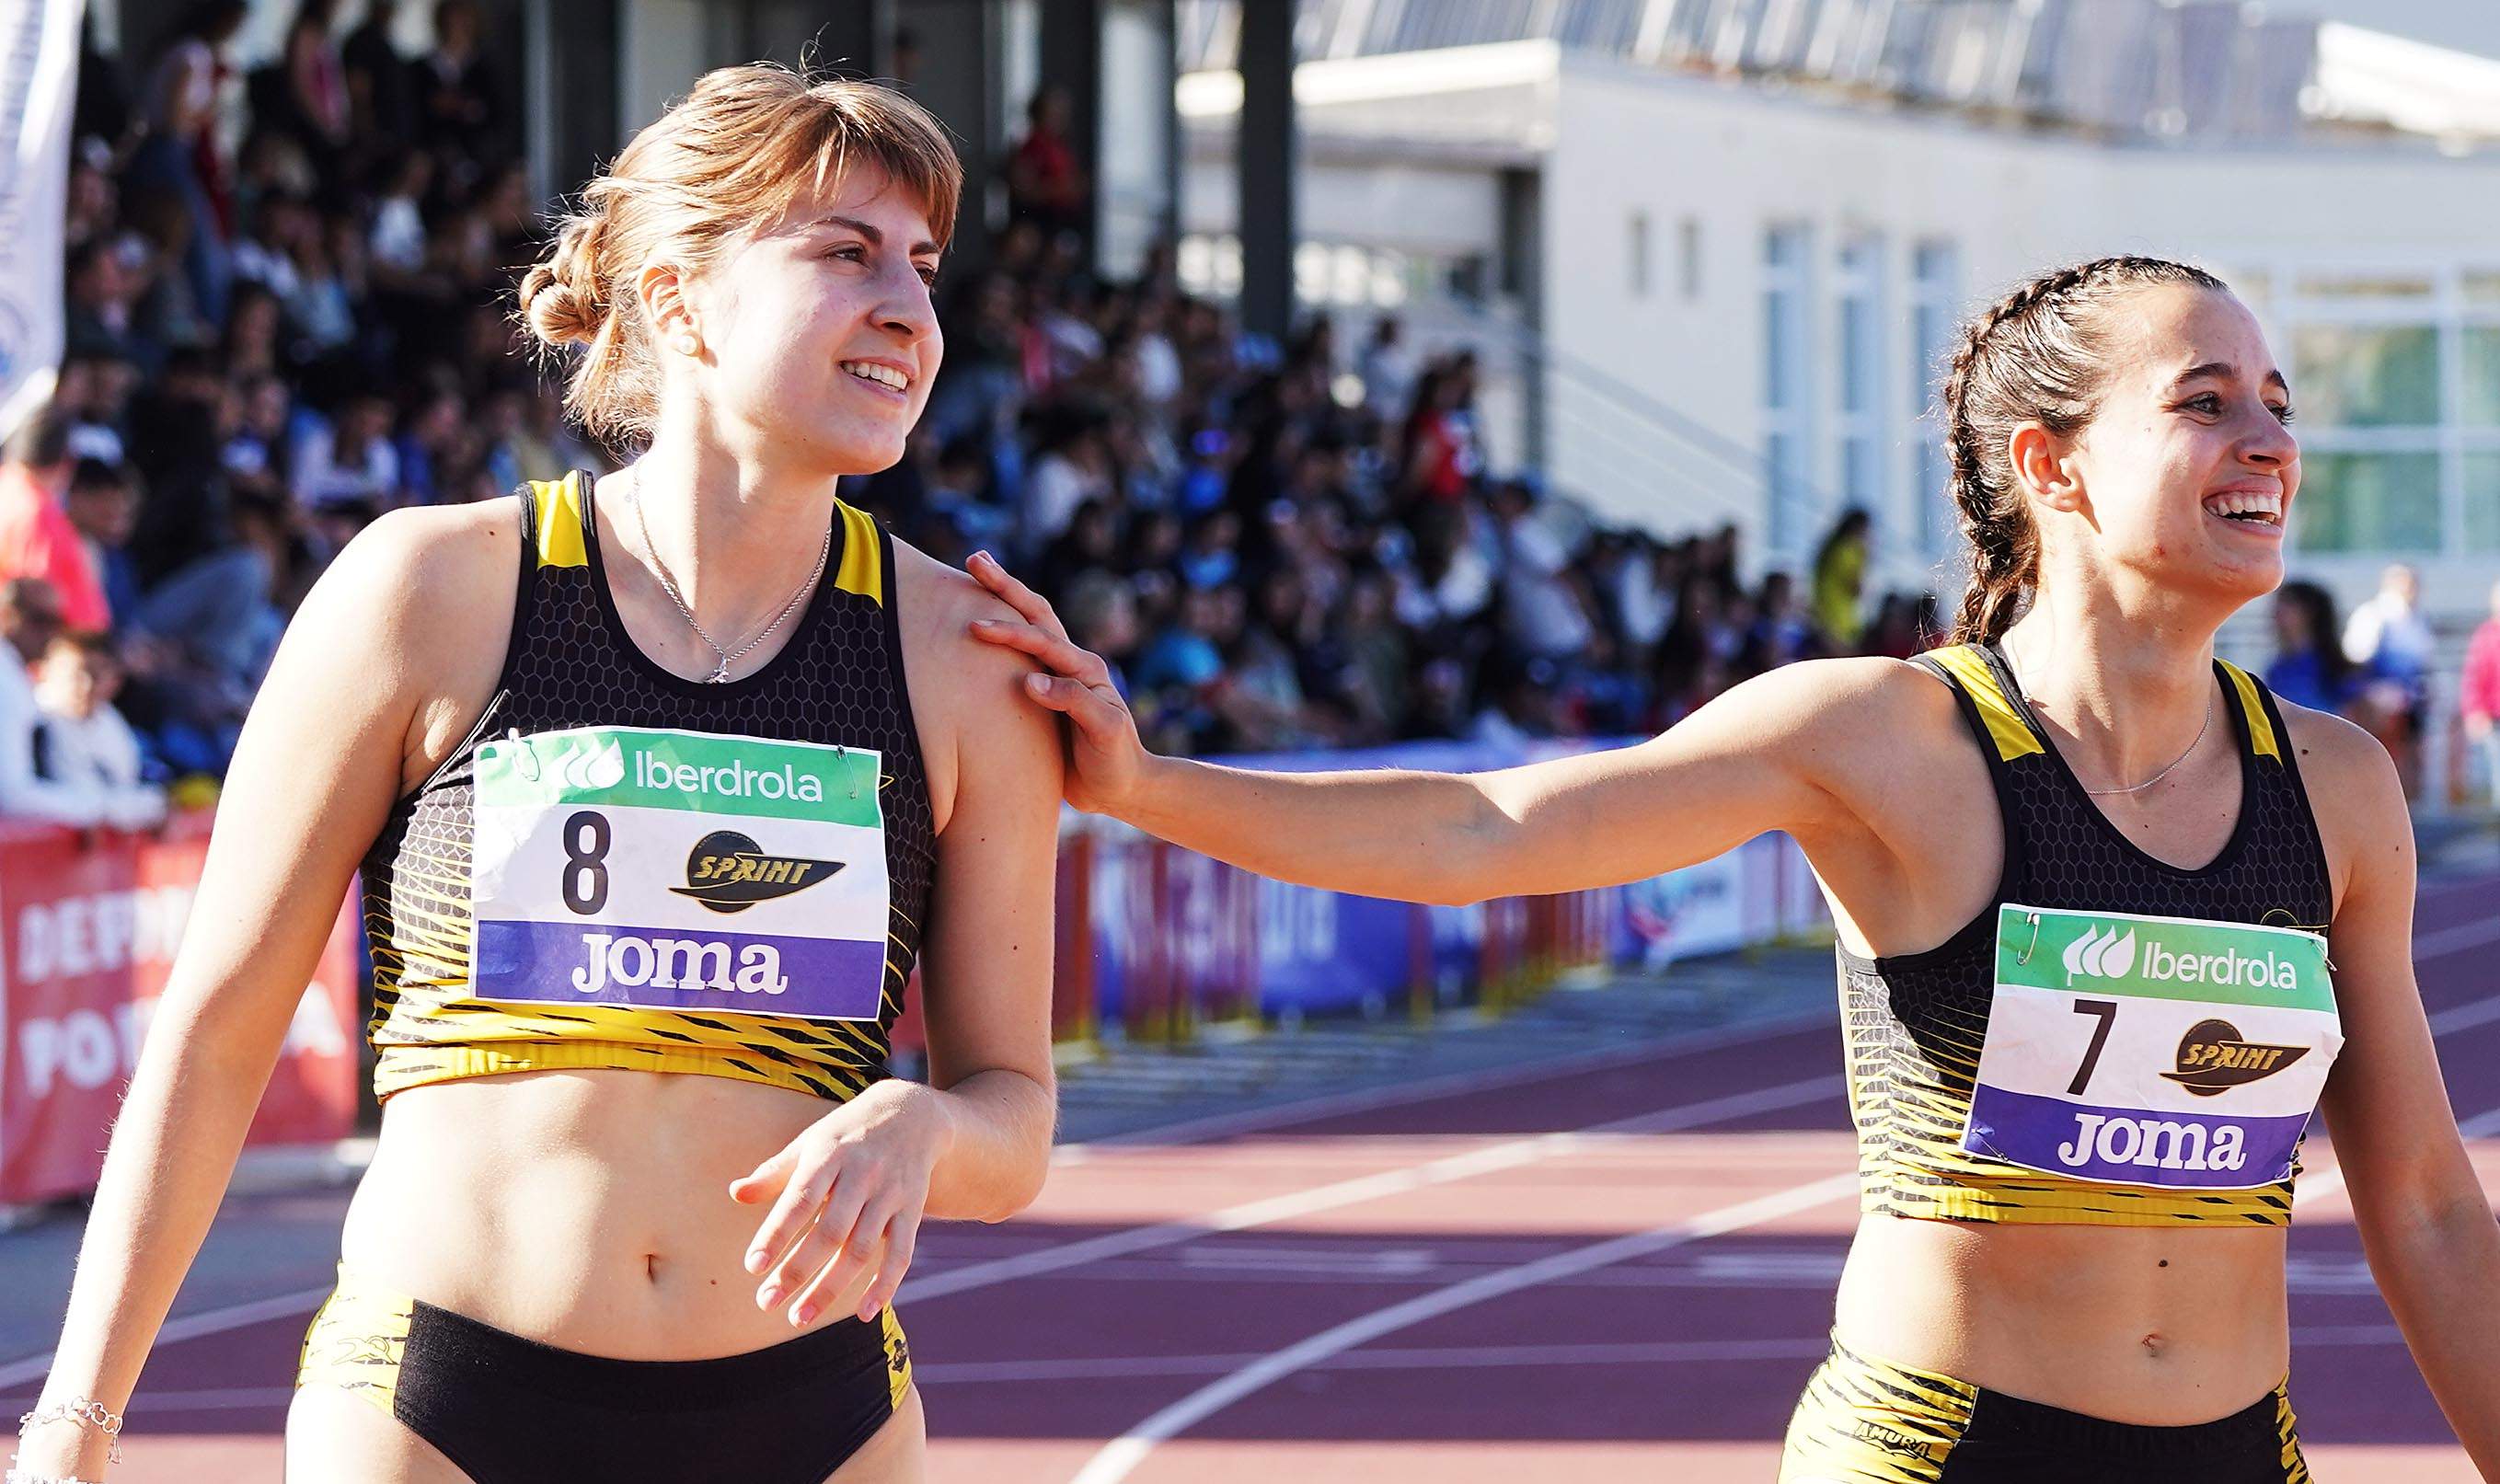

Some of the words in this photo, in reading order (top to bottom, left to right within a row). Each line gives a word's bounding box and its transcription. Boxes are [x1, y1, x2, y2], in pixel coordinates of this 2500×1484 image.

[635, 750, 824, 802] Iberdrola
[562, 810, 611, 915] 8
[694, 856, 812, 884] SPRINT
[570, 932, 789, 995] Joma
[2142, 940, 2298, 990] Iberdrola
[2066, 998, 2118, 1097] 7
[2181, 1043, 2284, 1070] SPRINT
[2056, 1113, 2248, 1172] Joma
